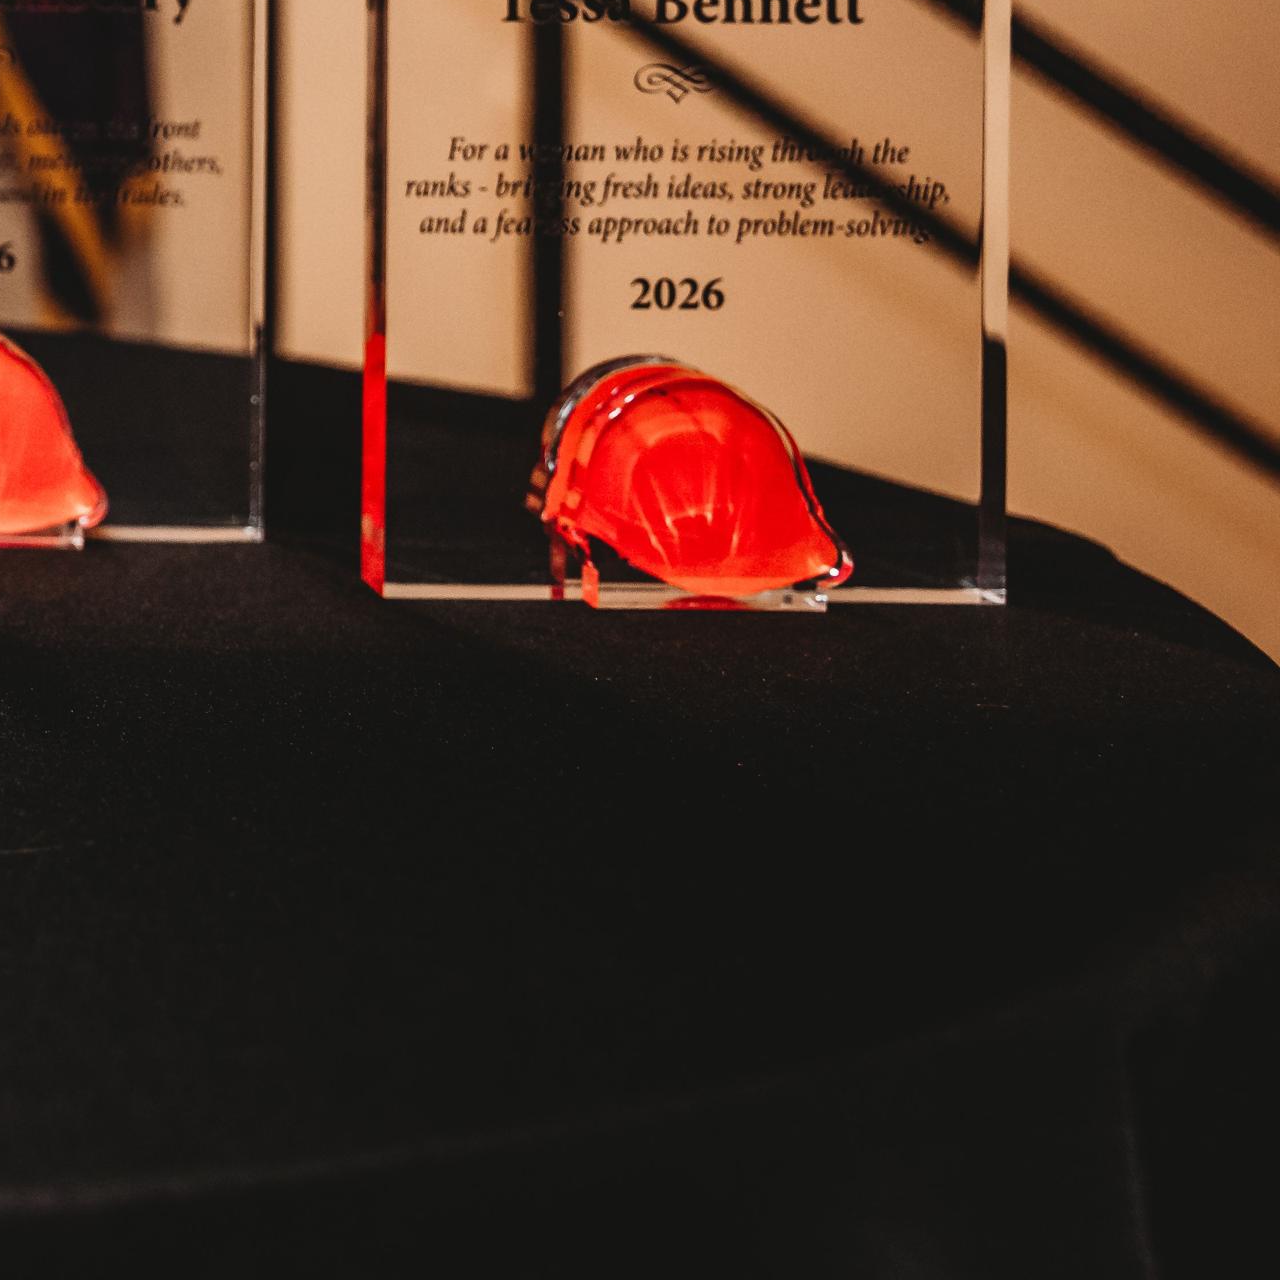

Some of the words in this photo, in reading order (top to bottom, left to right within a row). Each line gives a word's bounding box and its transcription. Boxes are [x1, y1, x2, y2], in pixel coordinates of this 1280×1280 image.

[447, 136, 490, 162] For
[494, 144, 510, 162] a
[614, 136, 664, 162] who
[671, 138, 690, 163] is
[697, 139, 765, 172] rising
[871, 137, 910, 164] the
[404, 172, 471, 198] ranks
[597, 172, 659, 207] fresh
[667, 174, 734, 202] ideas,
[741, 176, 817, 208] strong
[419, 208, 468, 234] and
[472, 217, 489, 234] a
[588, 210, 699, 243] approach
[707, 214, 731, 236] to
[630, 277, 726, 310] 2026
